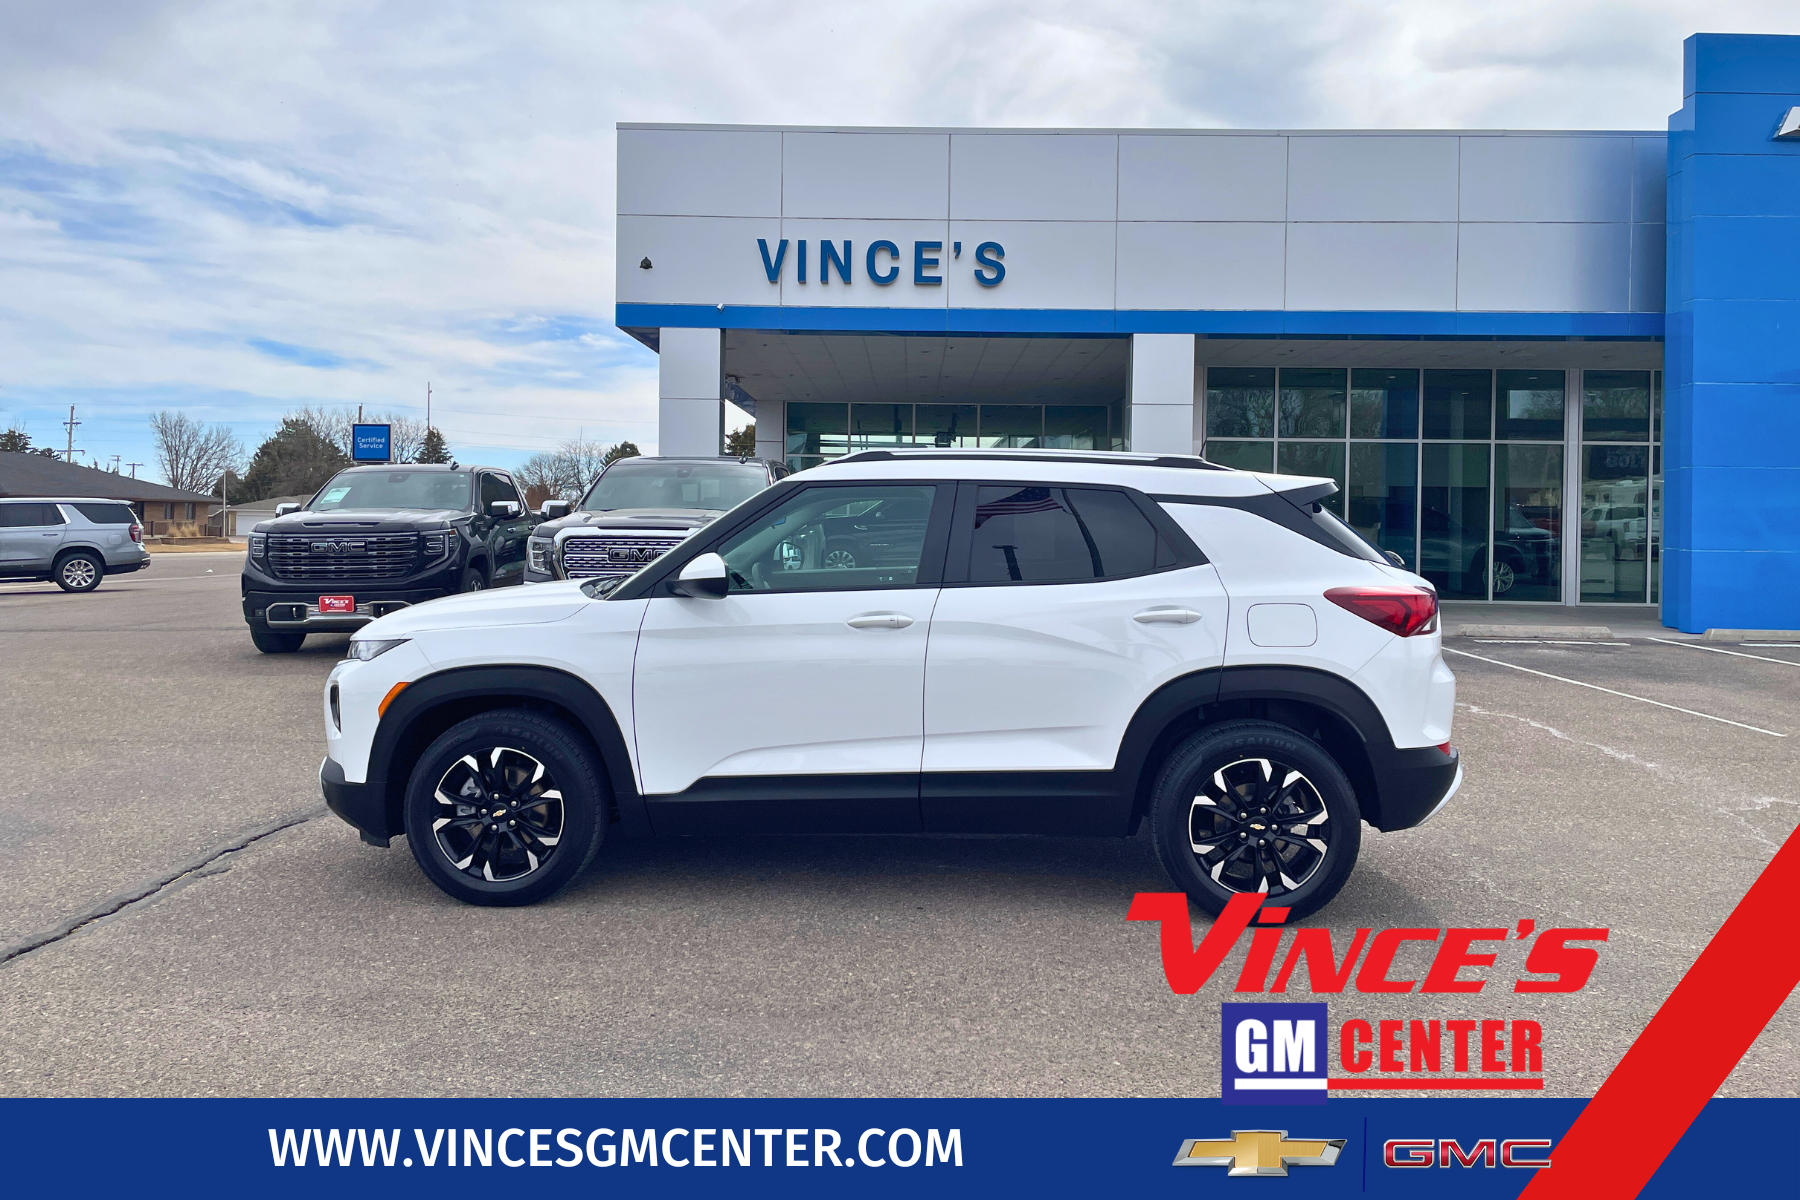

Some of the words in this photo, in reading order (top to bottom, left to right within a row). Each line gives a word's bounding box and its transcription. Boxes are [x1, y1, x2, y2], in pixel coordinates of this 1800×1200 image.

[757, 239, 1007, 287] VINCE'S
[311, 542, 365, 552] GMC
[609, 549, 669, 561] GM
